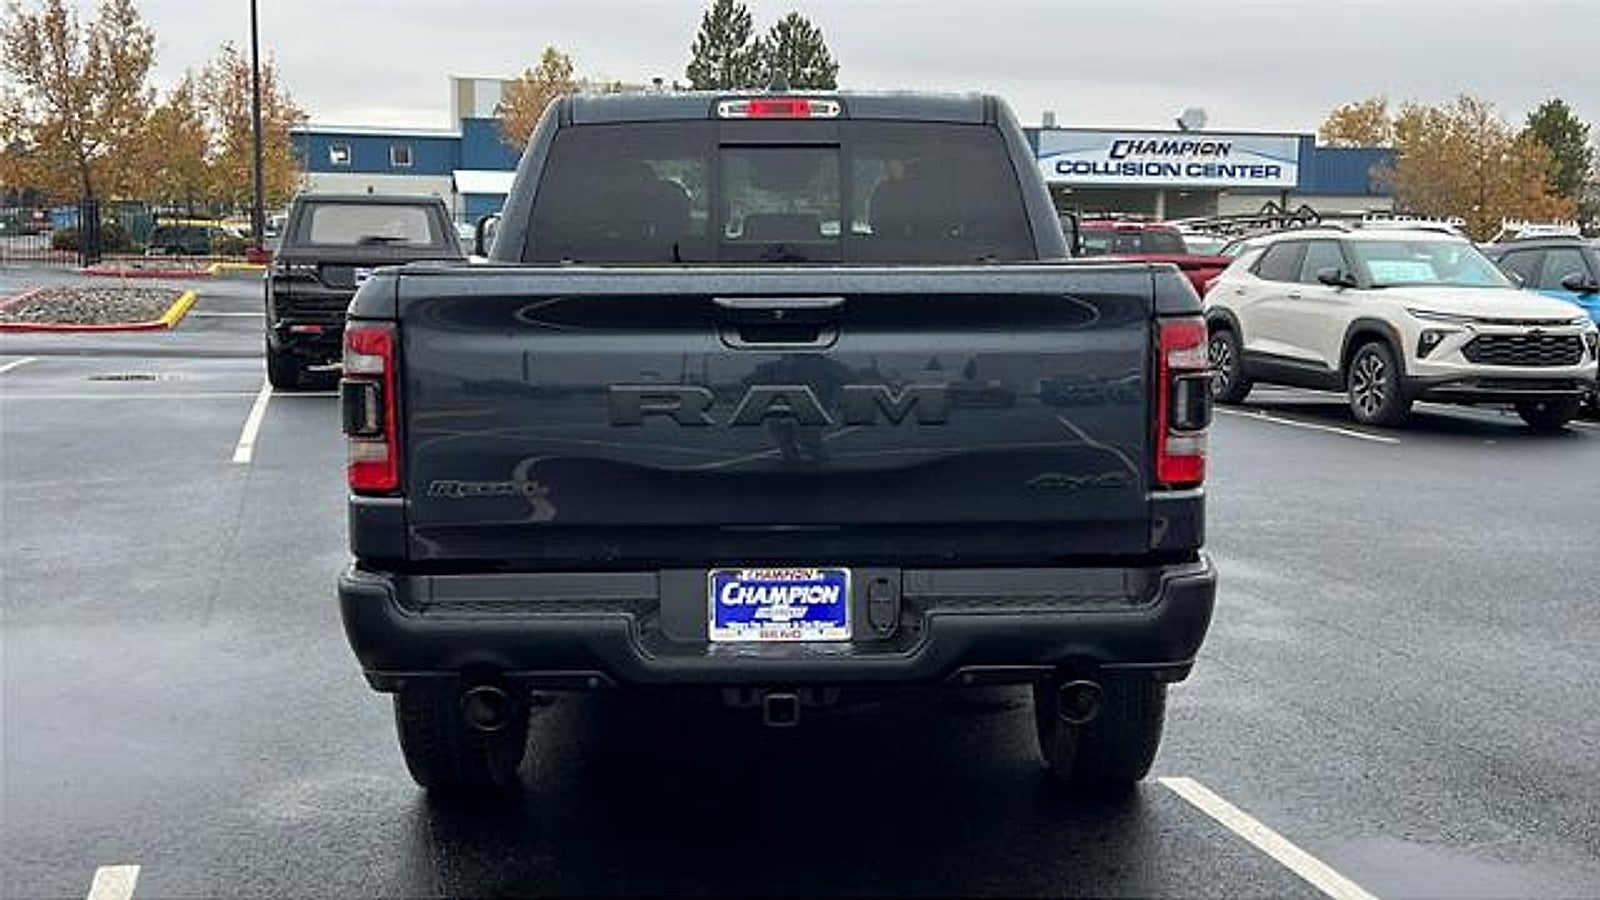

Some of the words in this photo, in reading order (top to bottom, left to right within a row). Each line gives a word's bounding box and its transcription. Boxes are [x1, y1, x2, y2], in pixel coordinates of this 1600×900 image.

[1109, 139, 1232, 159] CHAMPION
[1055, 160, 1181, 178] COLLISION
[1185, 162, 1282, 179] CENTER
[609, 383, 952, 426] RAM
[721, 582, 840, 605] CHAMPION
